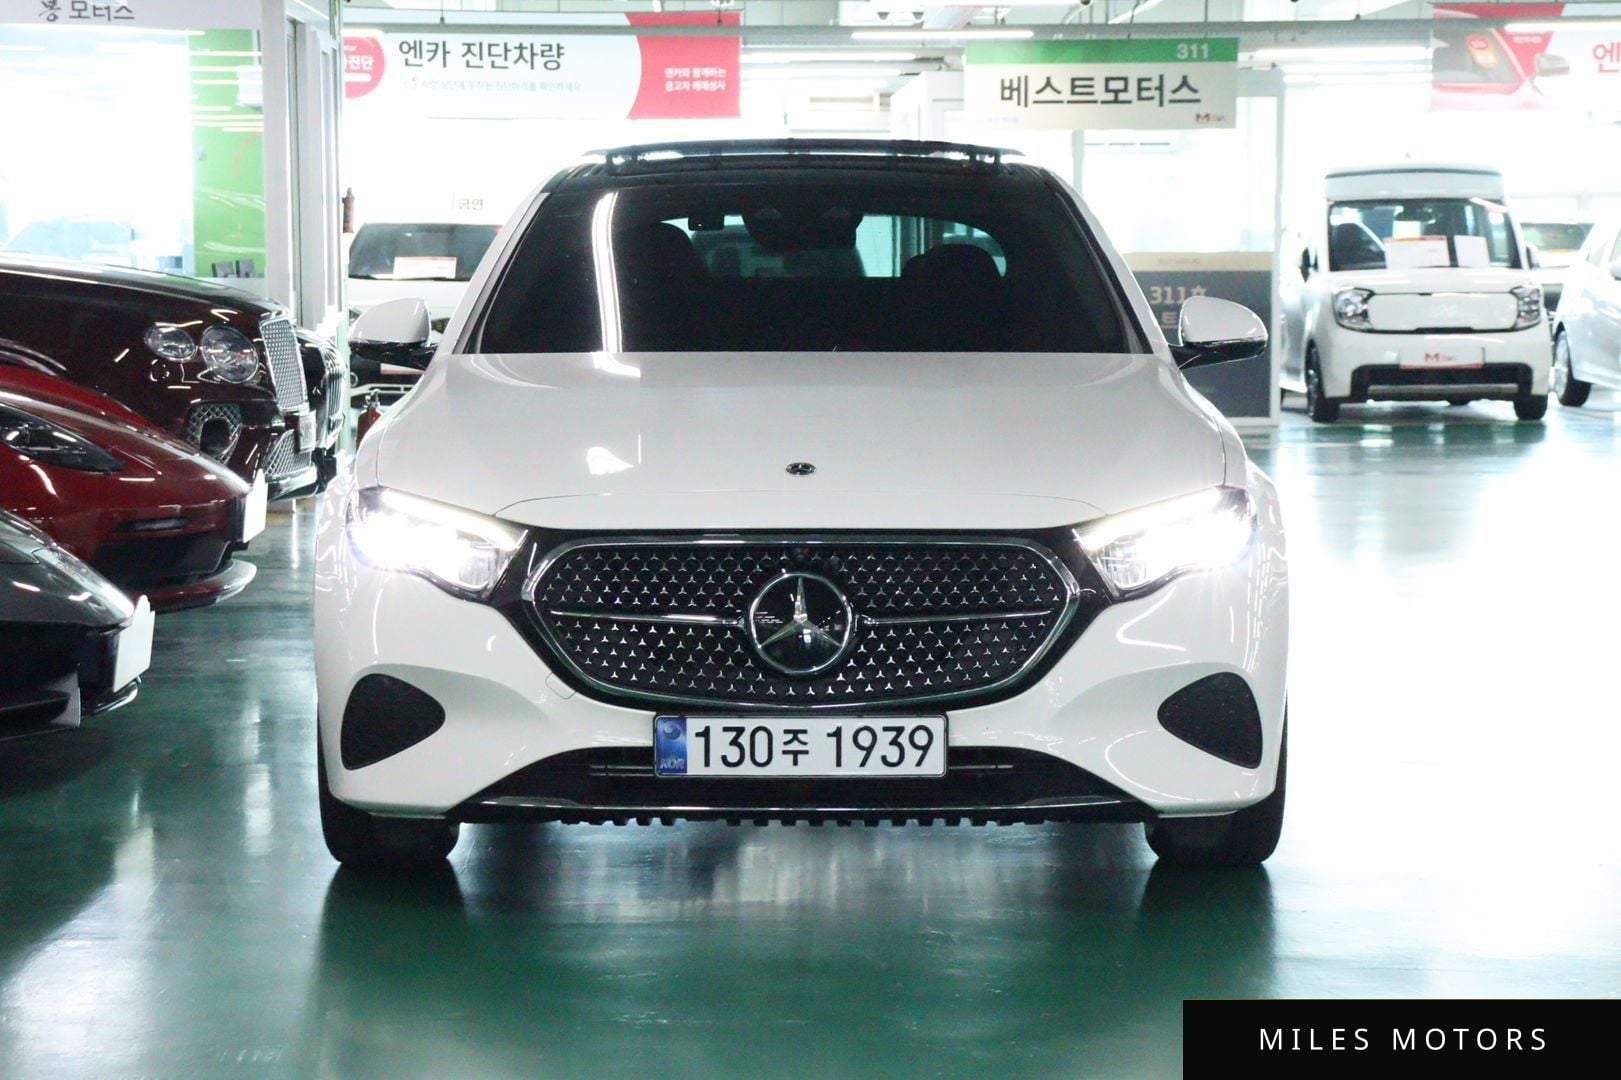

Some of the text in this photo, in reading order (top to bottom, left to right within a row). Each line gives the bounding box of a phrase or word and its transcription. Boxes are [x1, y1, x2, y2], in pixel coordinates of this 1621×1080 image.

[69, 0, 135, 21] 모터스
[398, 40, 565, 71] 엔카 진단차량
[1176, 43, 1209, 60] 311
[1000, 74, 1202, 108] 베스트모터스
[695, 725, 934, 768] 130주 1939
[659, 758, 685, 770] KOR
